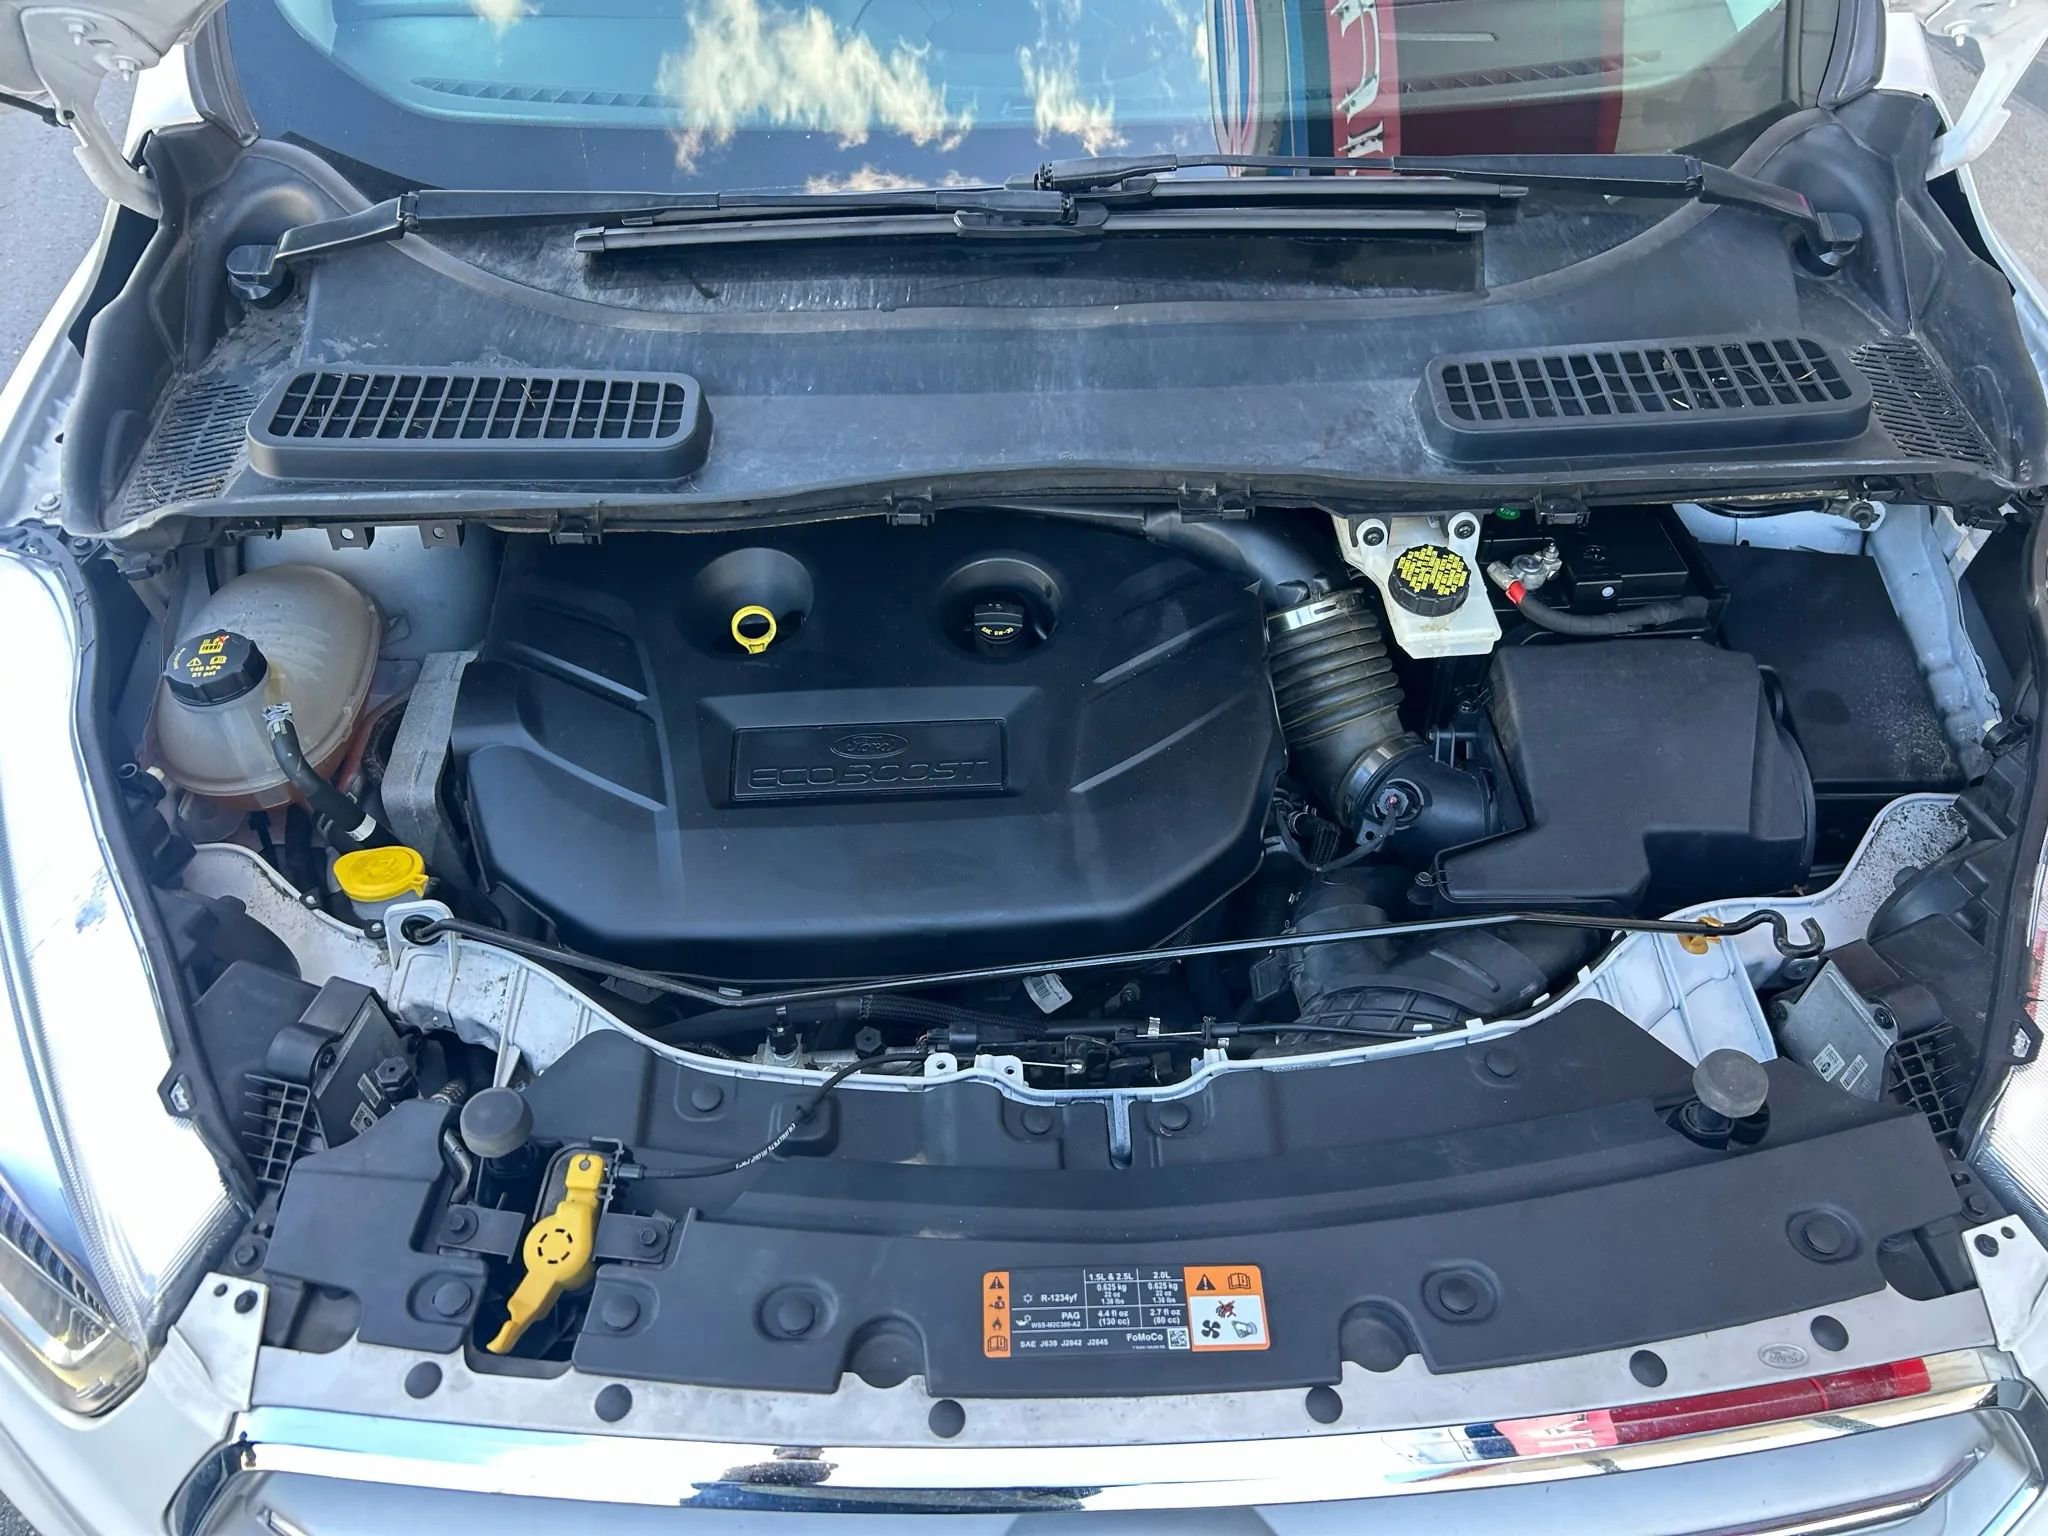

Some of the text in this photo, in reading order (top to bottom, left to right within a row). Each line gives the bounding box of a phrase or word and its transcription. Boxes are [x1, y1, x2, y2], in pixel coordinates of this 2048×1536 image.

[748, 761, 989, 789] ECOBOOST
[1089, 1272, 1134, 1281] 1.5L & 2.5L
[1152, 1271, 1171, 1279] 2.0L
[1096, 1283, 1127, 1292] 0.625 kg
[1147, 1282, 1178, 1291] 0.625 kg
[1040, 1293, 1078, 1304] R-1234yf
[1061, 1311, 1080, 1320] PAG
[1097, 1309, 1110, 1317] 4.4
[1111, 1309, 1118, 1317] fl
[1149, 1308, 1162, 1316] 2.7
[1163, 1308, 1169, 1316] fl
[1099, 1317, 1130, 1327] (130 cc)
[1153, 1316, 1180, 1326] (80 cc)
[1126, 1332, 1164, 1342] FoMoCo
[1020, 1340, 1036, 1348] SAE
